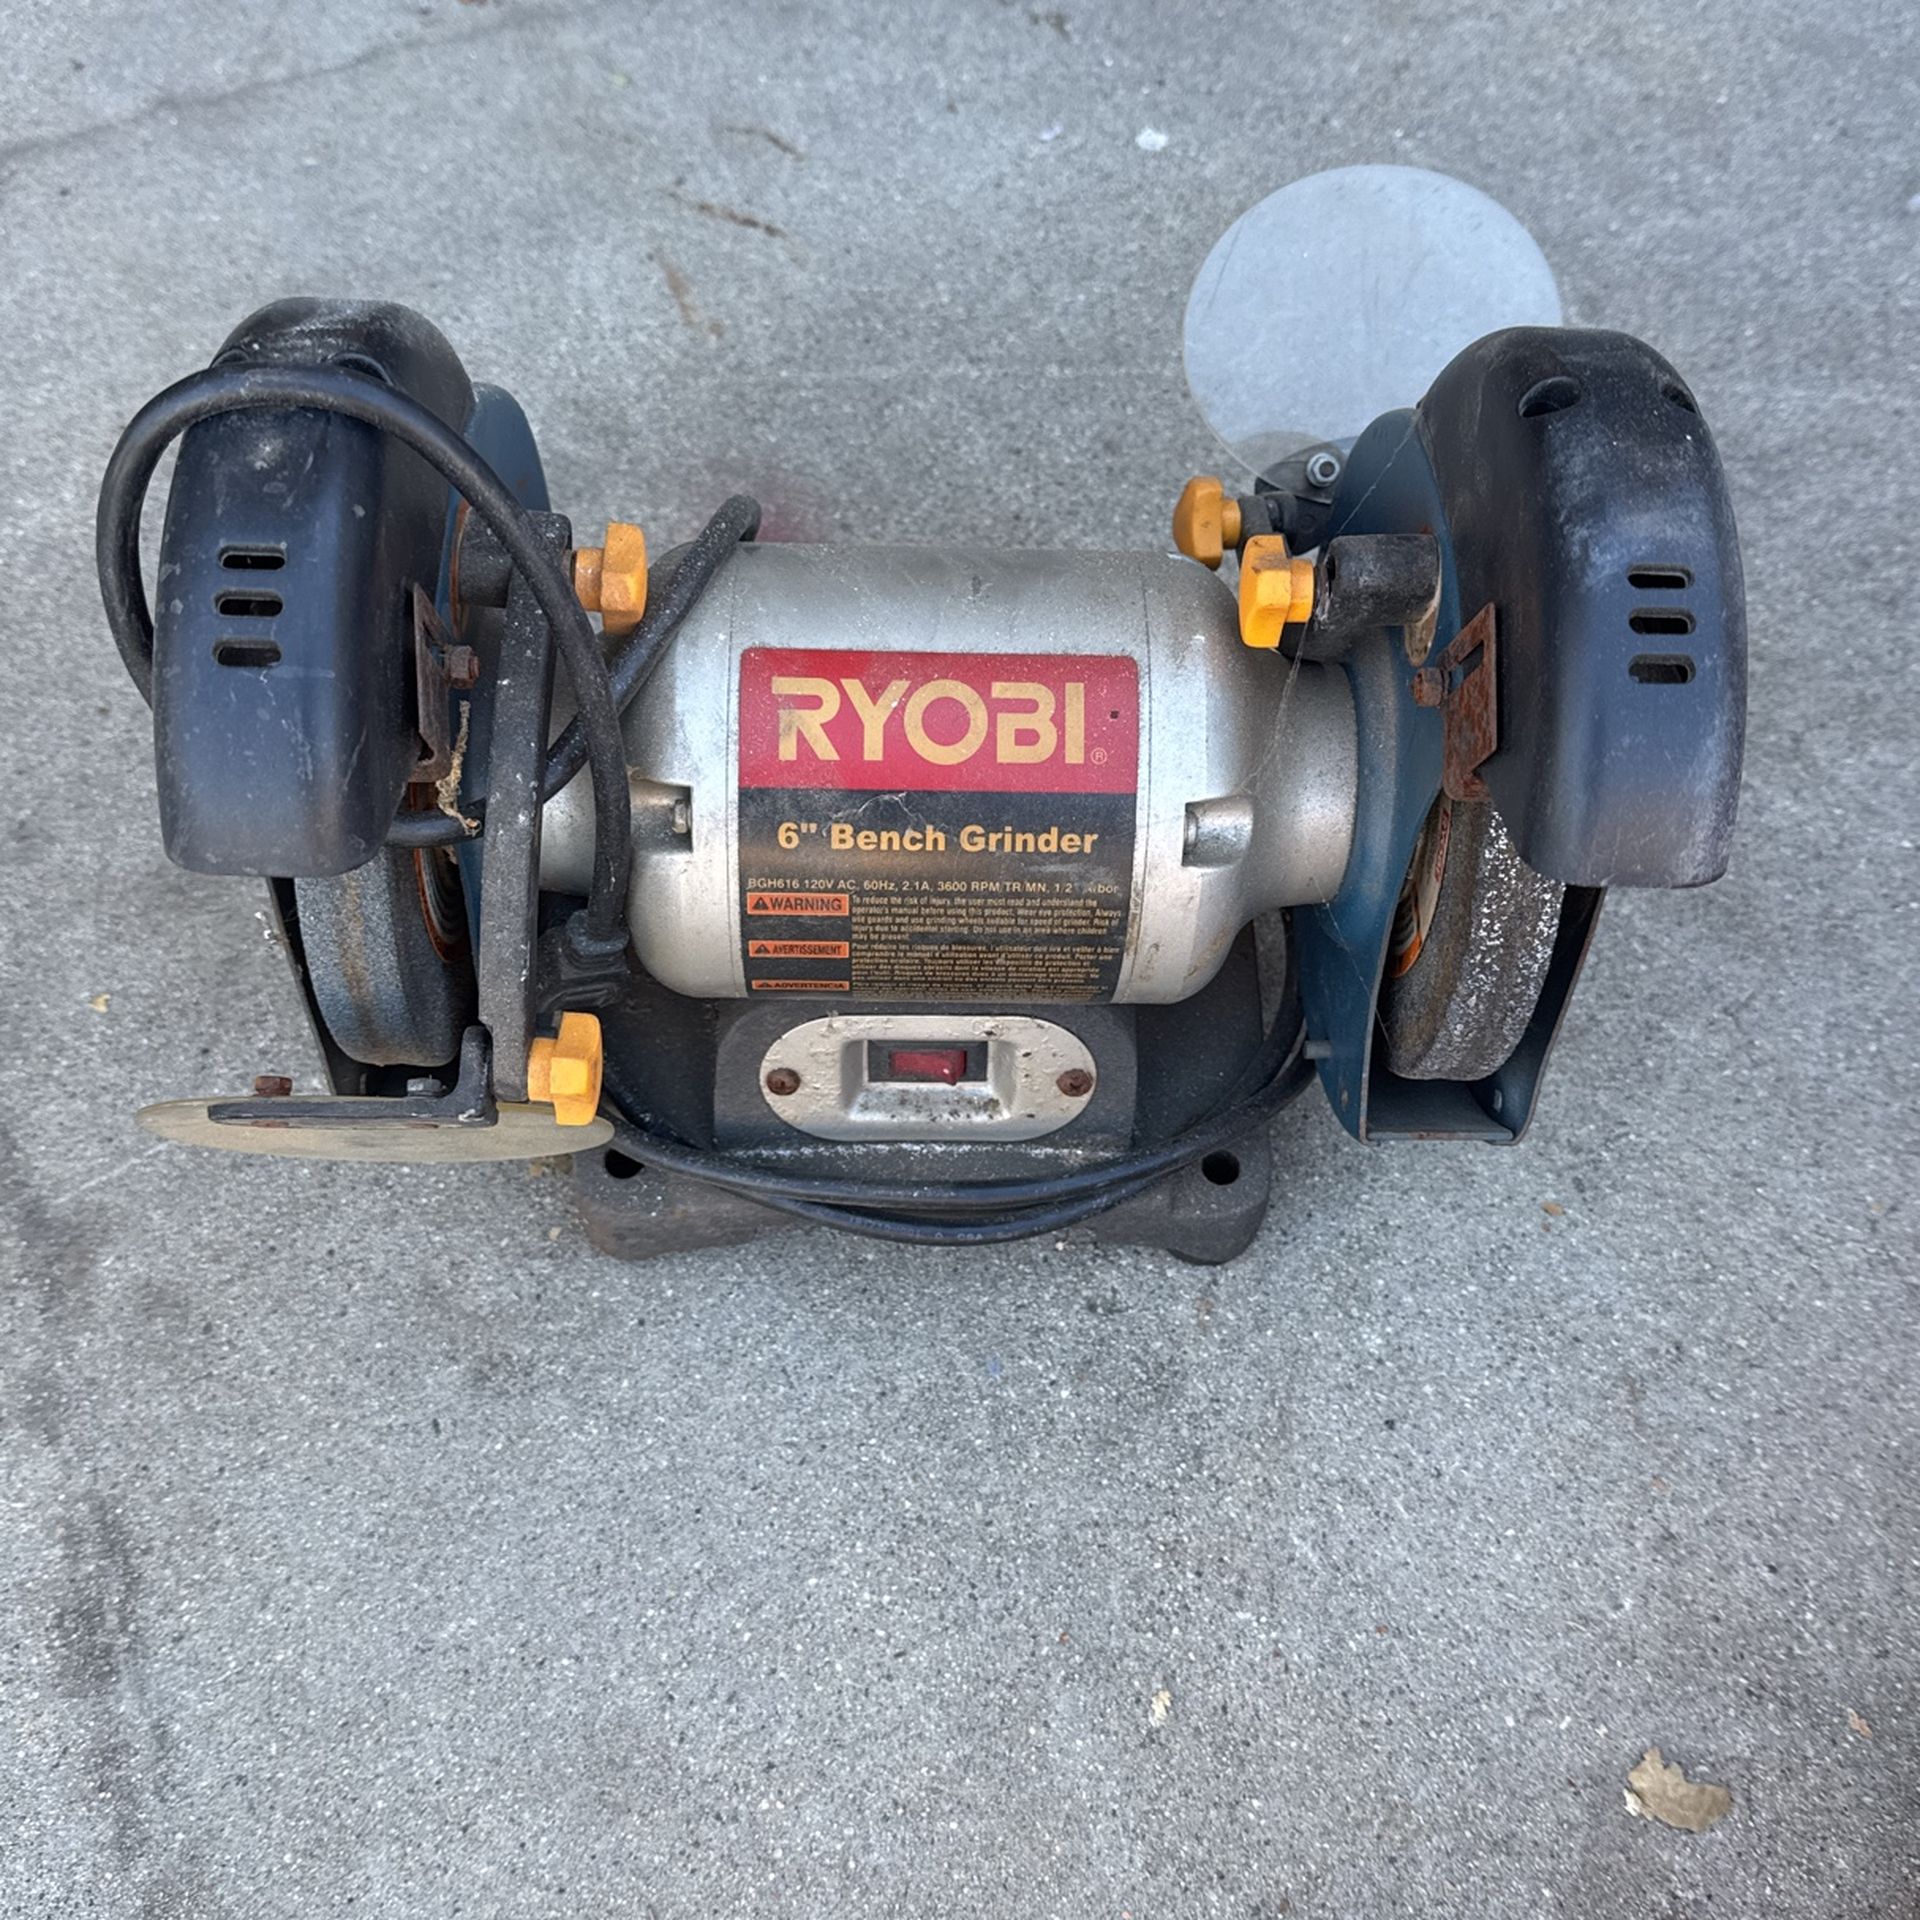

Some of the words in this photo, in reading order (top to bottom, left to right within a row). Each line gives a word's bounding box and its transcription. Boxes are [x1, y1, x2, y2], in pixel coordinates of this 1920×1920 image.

[772, 676, 1085, 765] RYOBI
[777, 822, 818, 850] 6"
[831, 823, 946, 851] Bench
[959, 825, 1099, 854] Grinder
[748, 878, 799, 889] BGH616
[804, 879, 834, 889] 120V
[863, 880, 899, 892] 60Hz,
[937, 881, 967, 892] 3600
[770, 898, 842, 911] WARNING
[773, 944, 842, 955] AVERTISSEMENT
